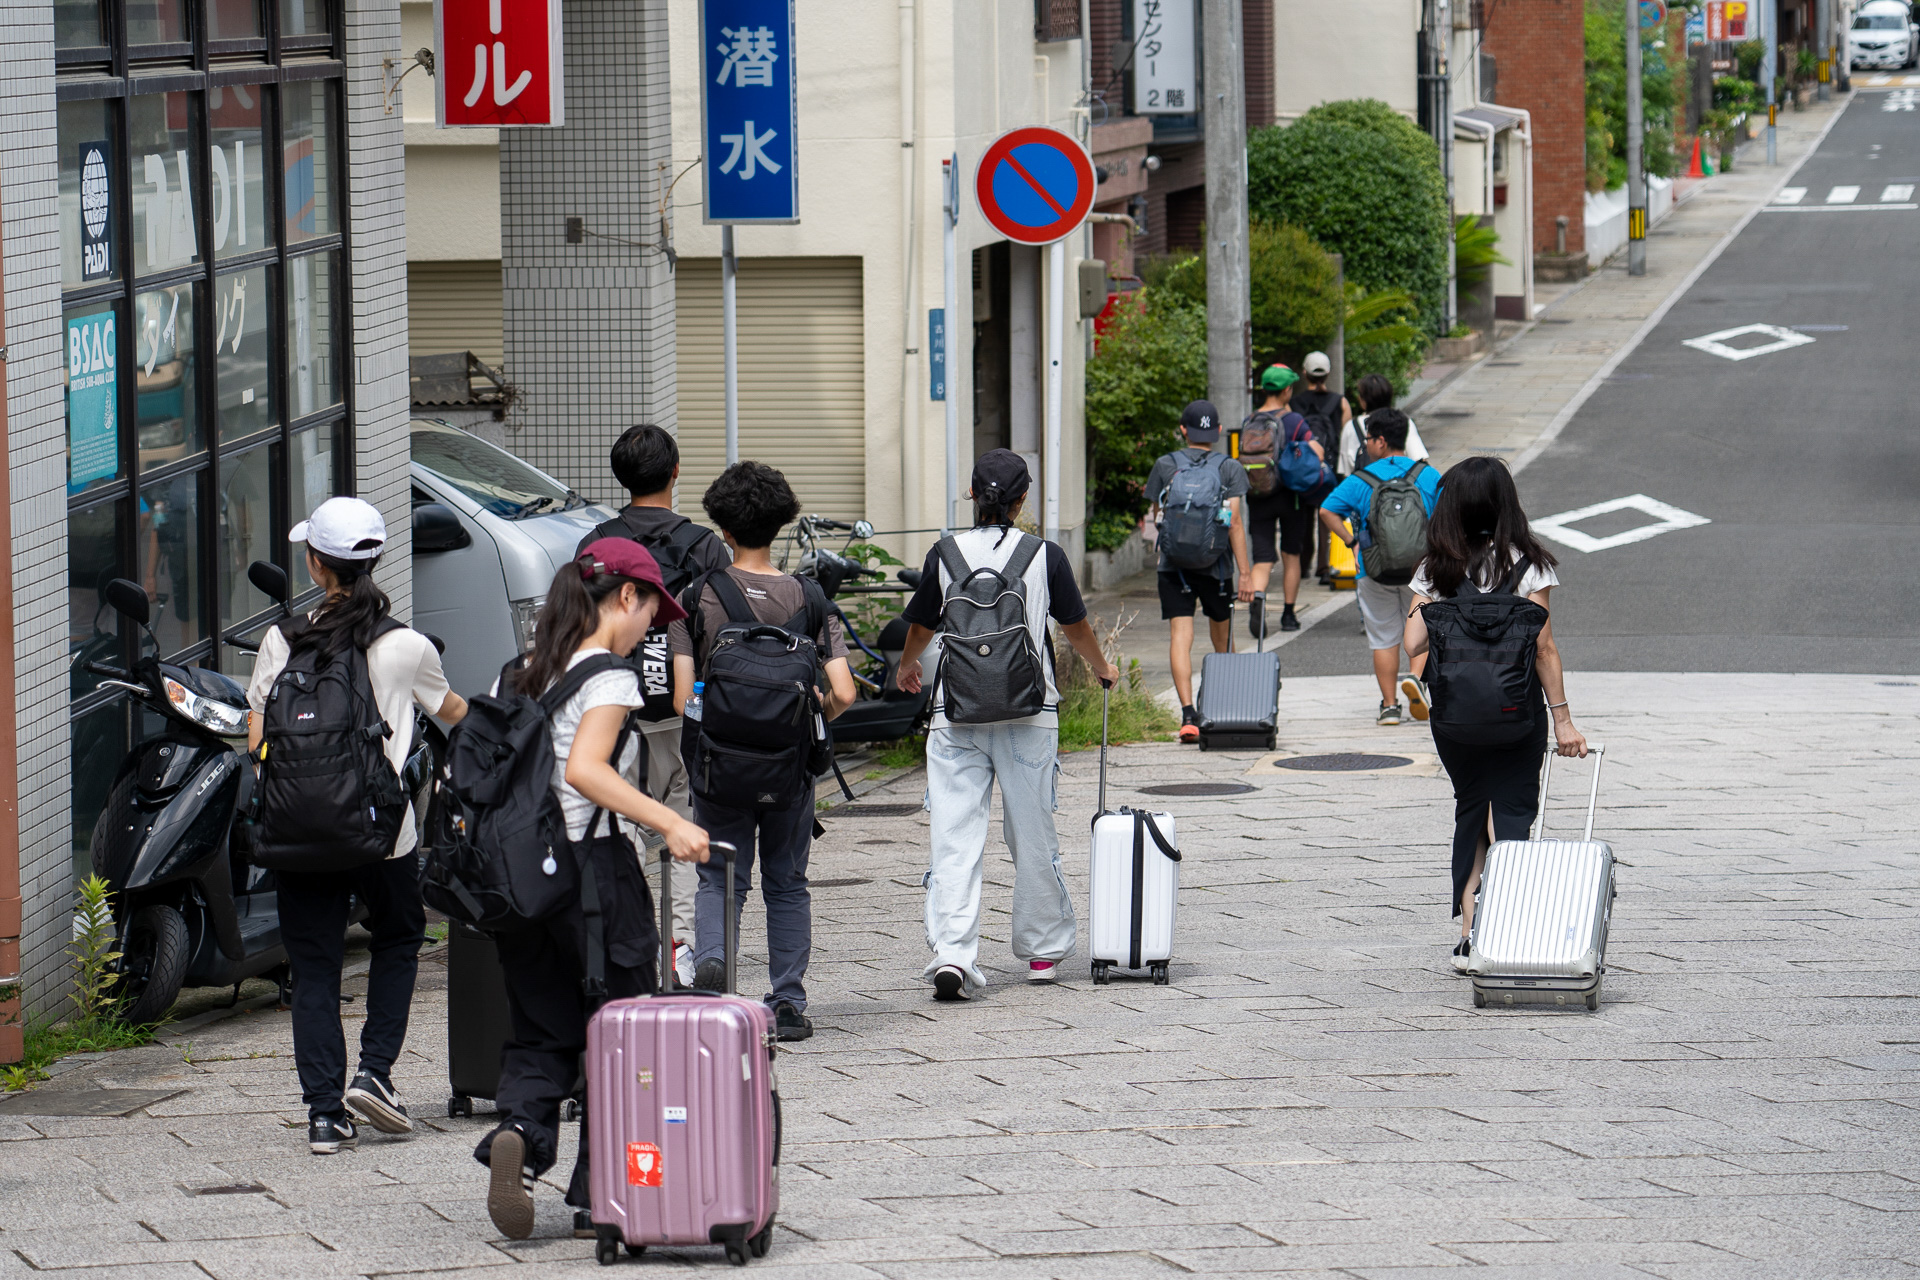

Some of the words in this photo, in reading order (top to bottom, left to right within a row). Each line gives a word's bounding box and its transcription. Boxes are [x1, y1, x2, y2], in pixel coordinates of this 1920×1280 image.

[1726, 2, 1747, 20] P
[715, 26, 783, 181] 潜水
[144, 140, 247, 267] PADI
[84, 241, 109, 275] PADI
[69, 318, 115, 377] BSAC
[70, 376, 86, 392] BRITISH
[86, 373, 105, 389] SUB-AQUA
[105, 370, 115, 384] CLUB
[642, 659, 670, 696] ERA
[196, 762, 225, 796] JOG
